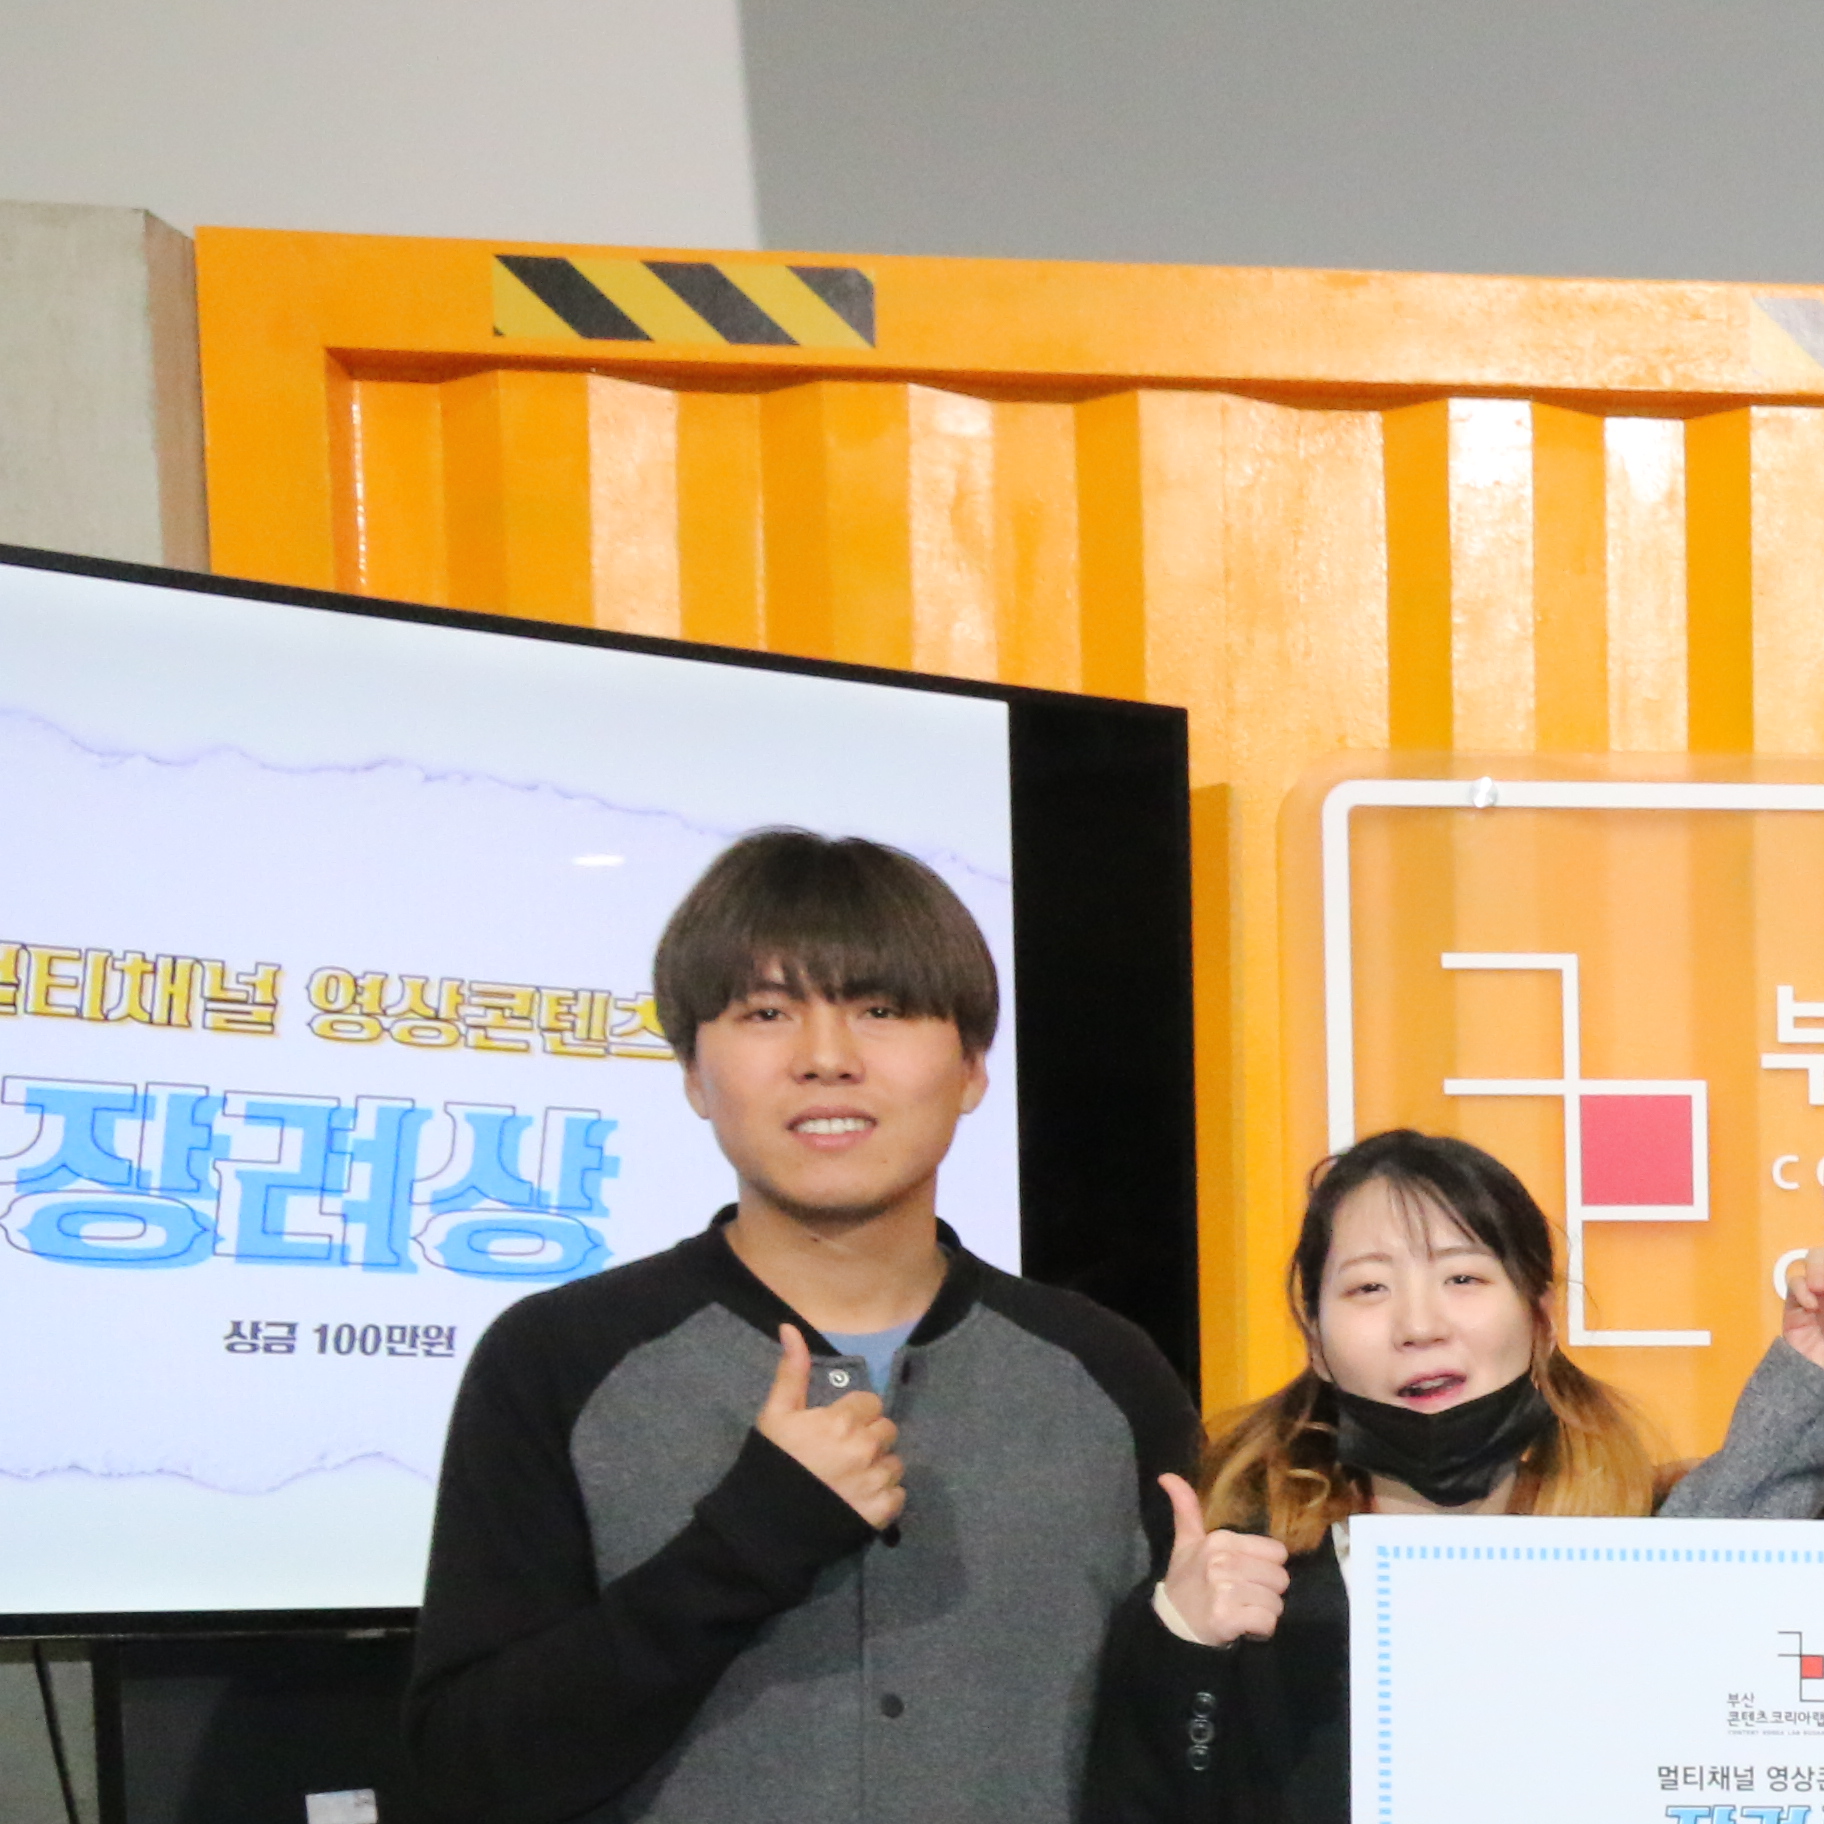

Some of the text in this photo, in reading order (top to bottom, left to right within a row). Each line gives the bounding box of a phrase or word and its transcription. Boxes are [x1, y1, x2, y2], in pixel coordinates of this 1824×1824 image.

[304, 966, 676, 1062] 영상콘텐츠
[0, 1075, 621, 1284] 장려상
[223, 1319, 457, 1359] 상금 100만원
[1727, 1692, 1755, 1708] 부산
[1657, 1765, 1755, 1792] 멀티채널
